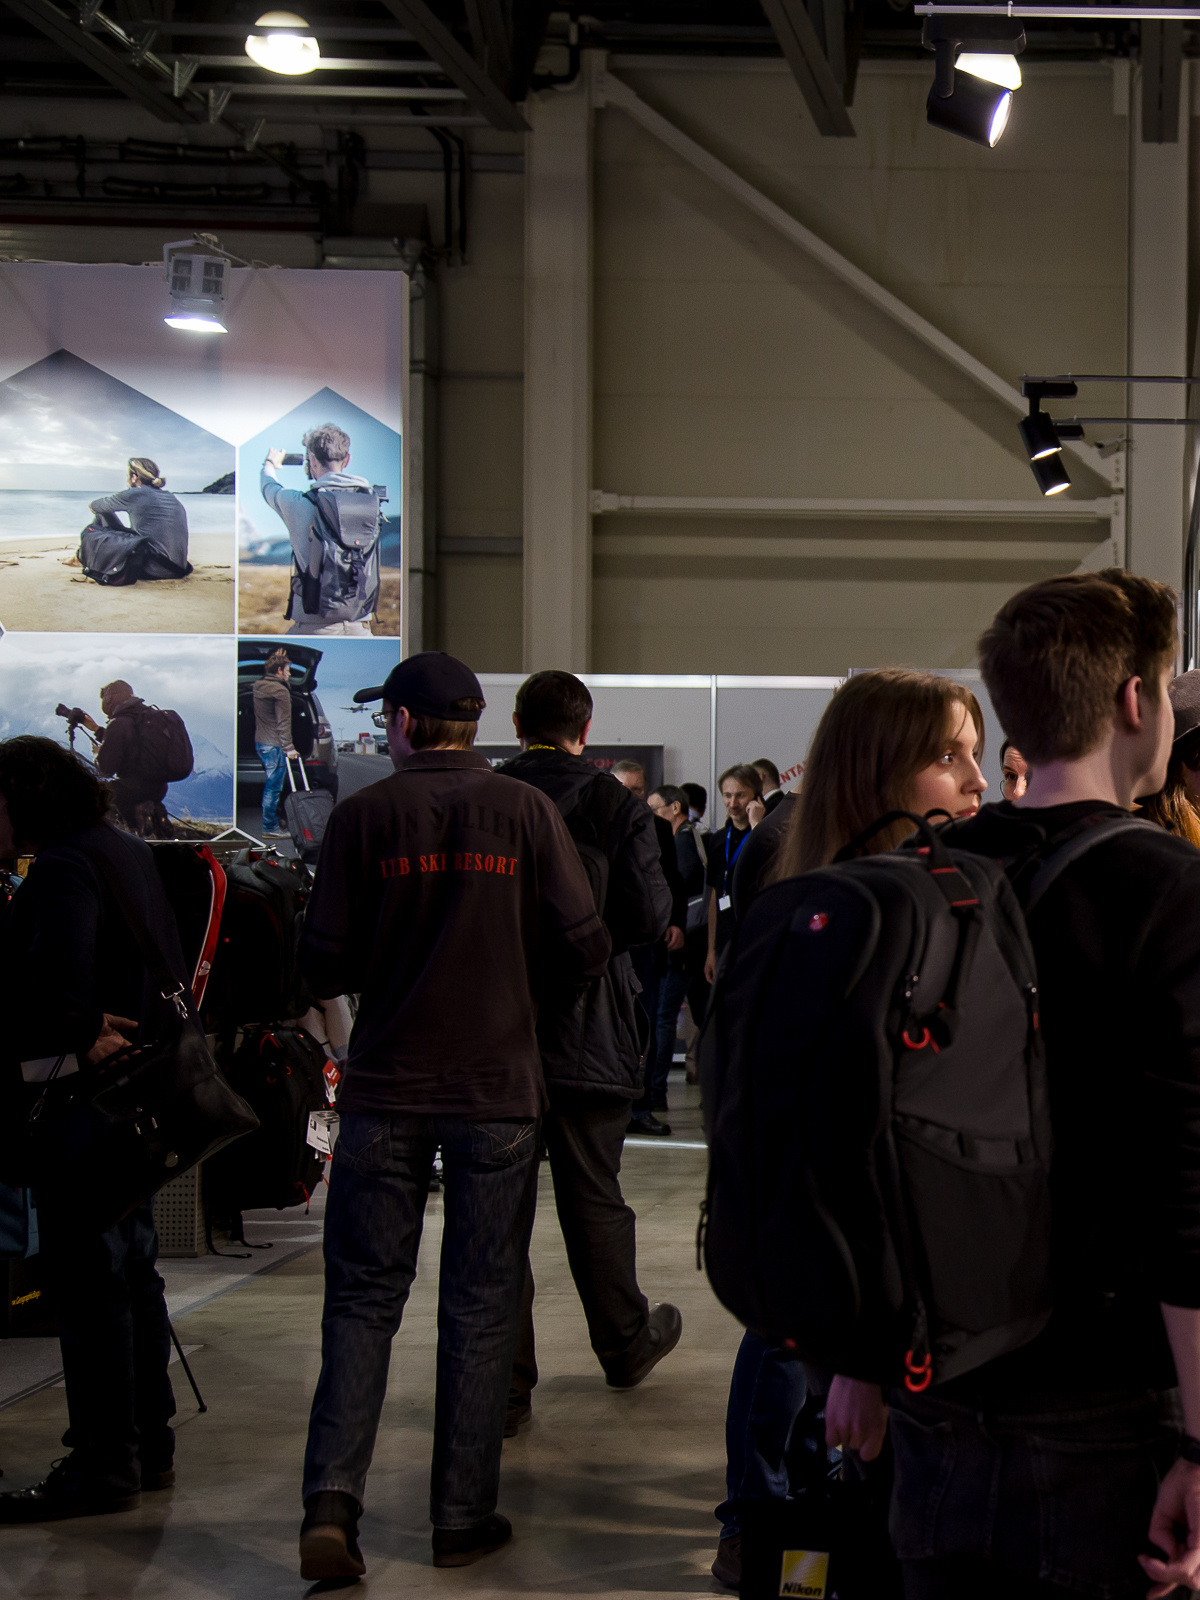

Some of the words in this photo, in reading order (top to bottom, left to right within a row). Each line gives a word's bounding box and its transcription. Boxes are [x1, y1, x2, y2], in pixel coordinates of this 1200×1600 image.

[419, 853, 447, 873] SKI
[453, 852, 518, 876] RESORT
[782, 1582, 823, 1597] Nikon
